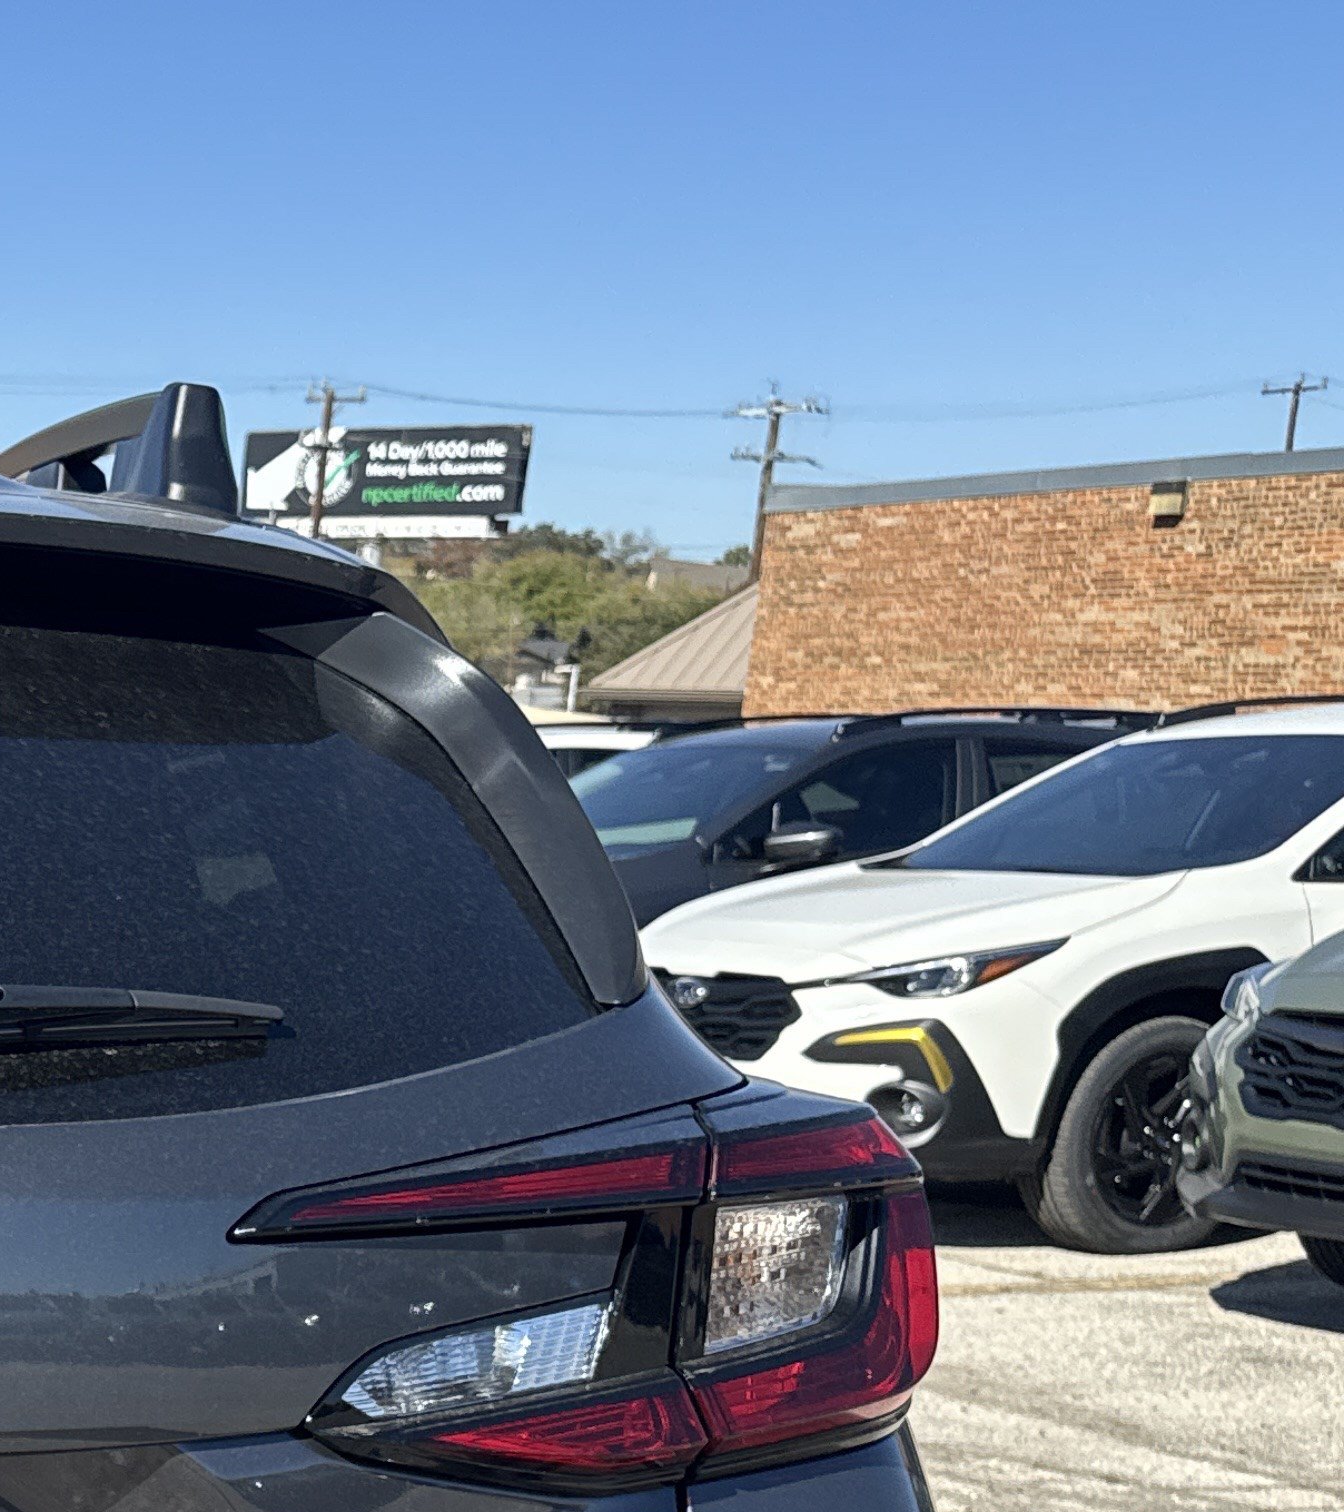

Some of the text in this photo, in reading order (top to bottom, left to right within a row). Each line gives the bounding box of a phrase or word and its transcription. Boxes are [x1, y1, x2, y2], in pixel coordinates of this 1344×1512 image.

[367, 440, 387, 461] 14
[470, 438, 508, 458] mile
[362, 480, 505, 507] npcertified.com
